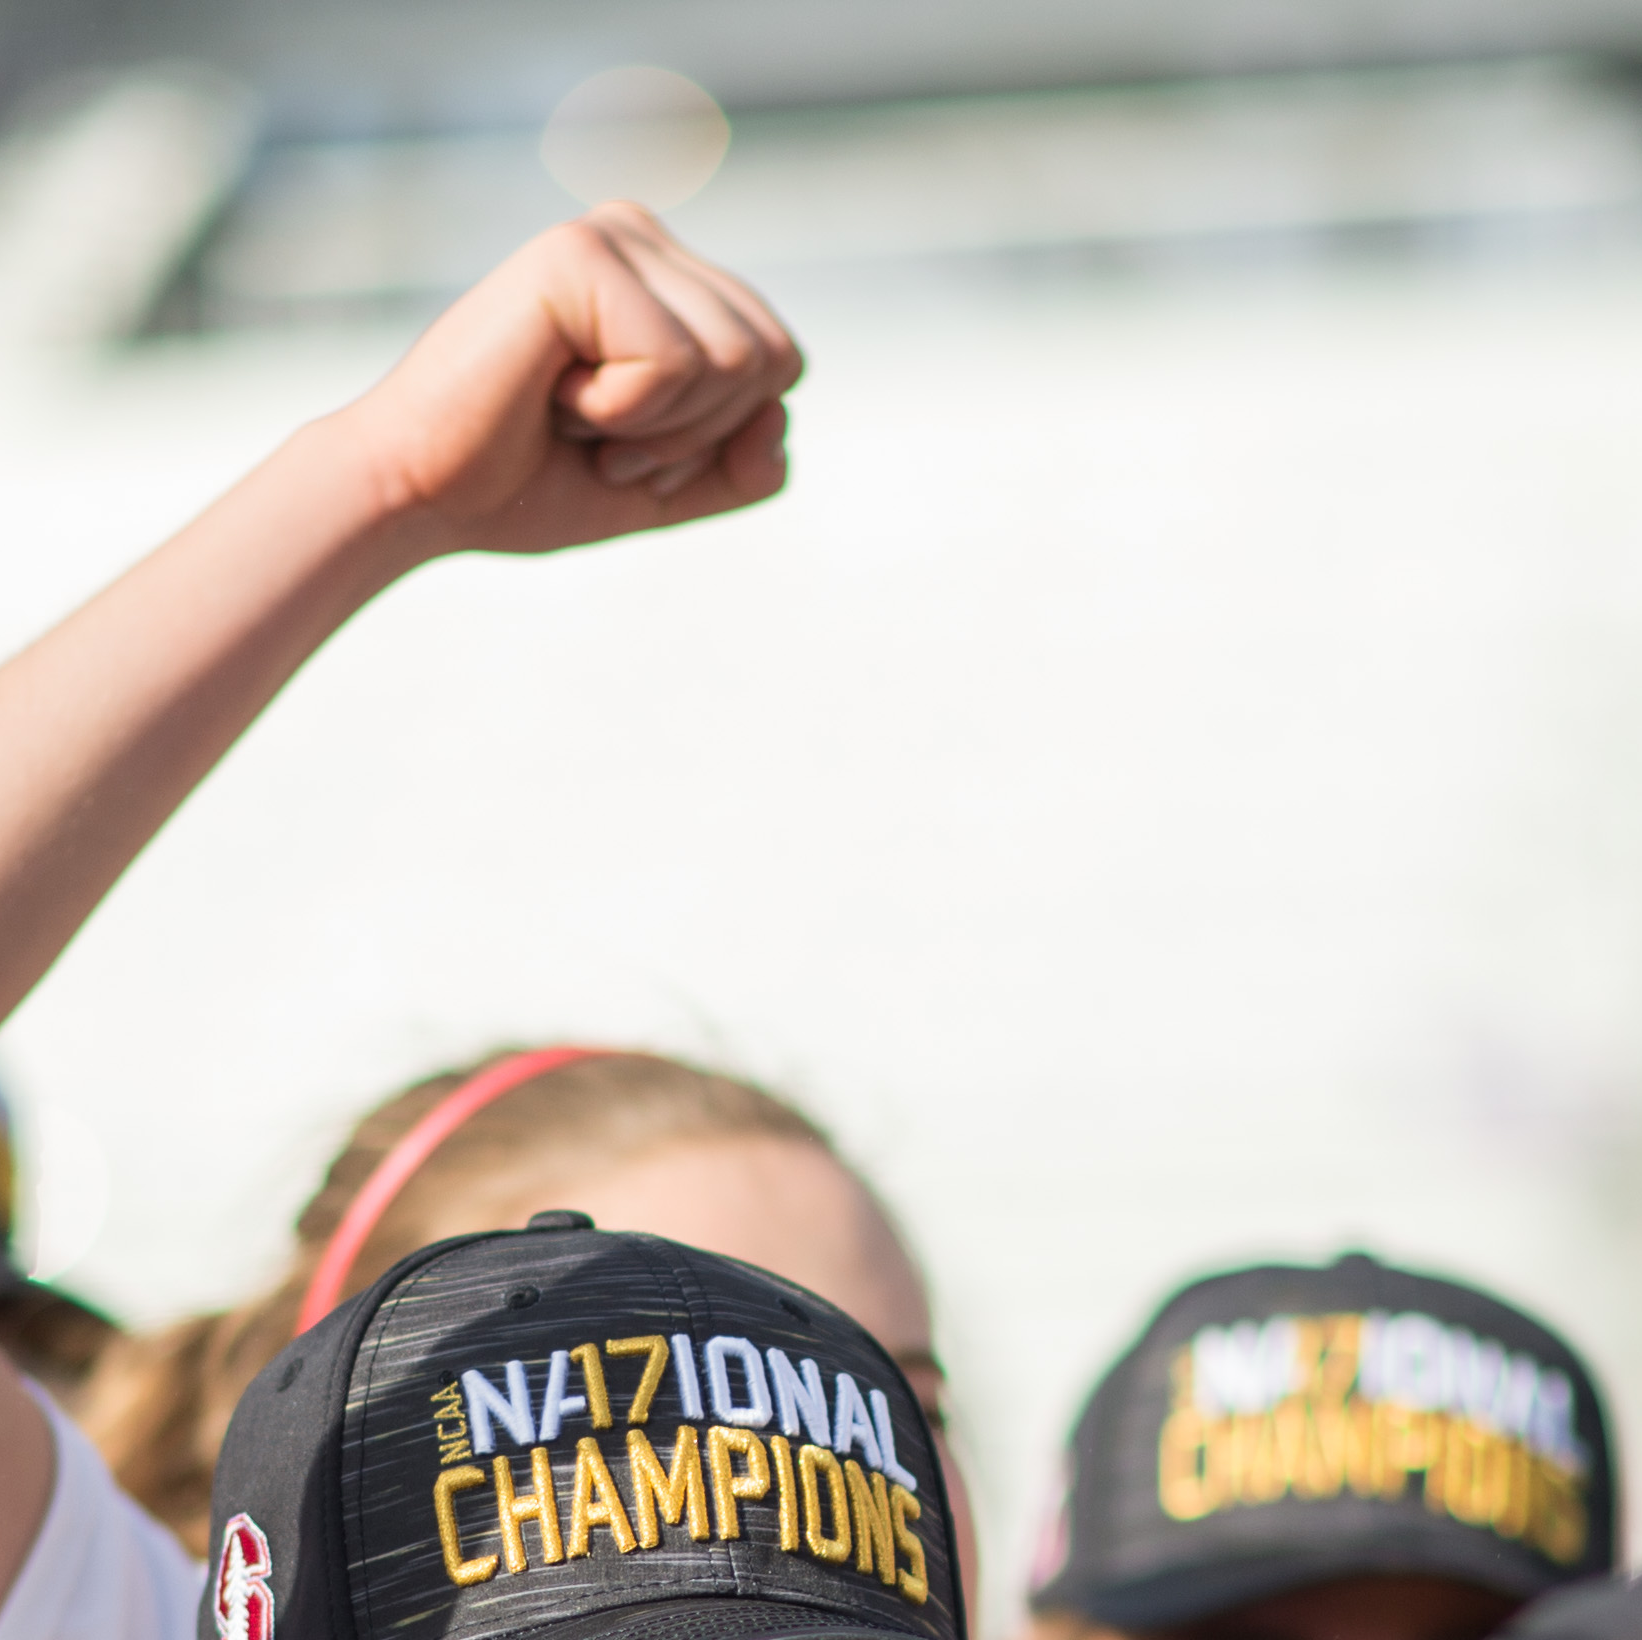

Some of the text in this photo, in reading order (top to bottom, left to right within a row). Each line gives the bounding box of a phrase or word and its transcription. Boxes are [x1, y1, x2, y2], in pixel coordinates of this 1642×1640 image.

[430, 1381, 472, 1465] NCAA
[461, 1333, 918, 1491] NA17IONAL
[433, 1424, 929, 1605] CHAMPIONS
